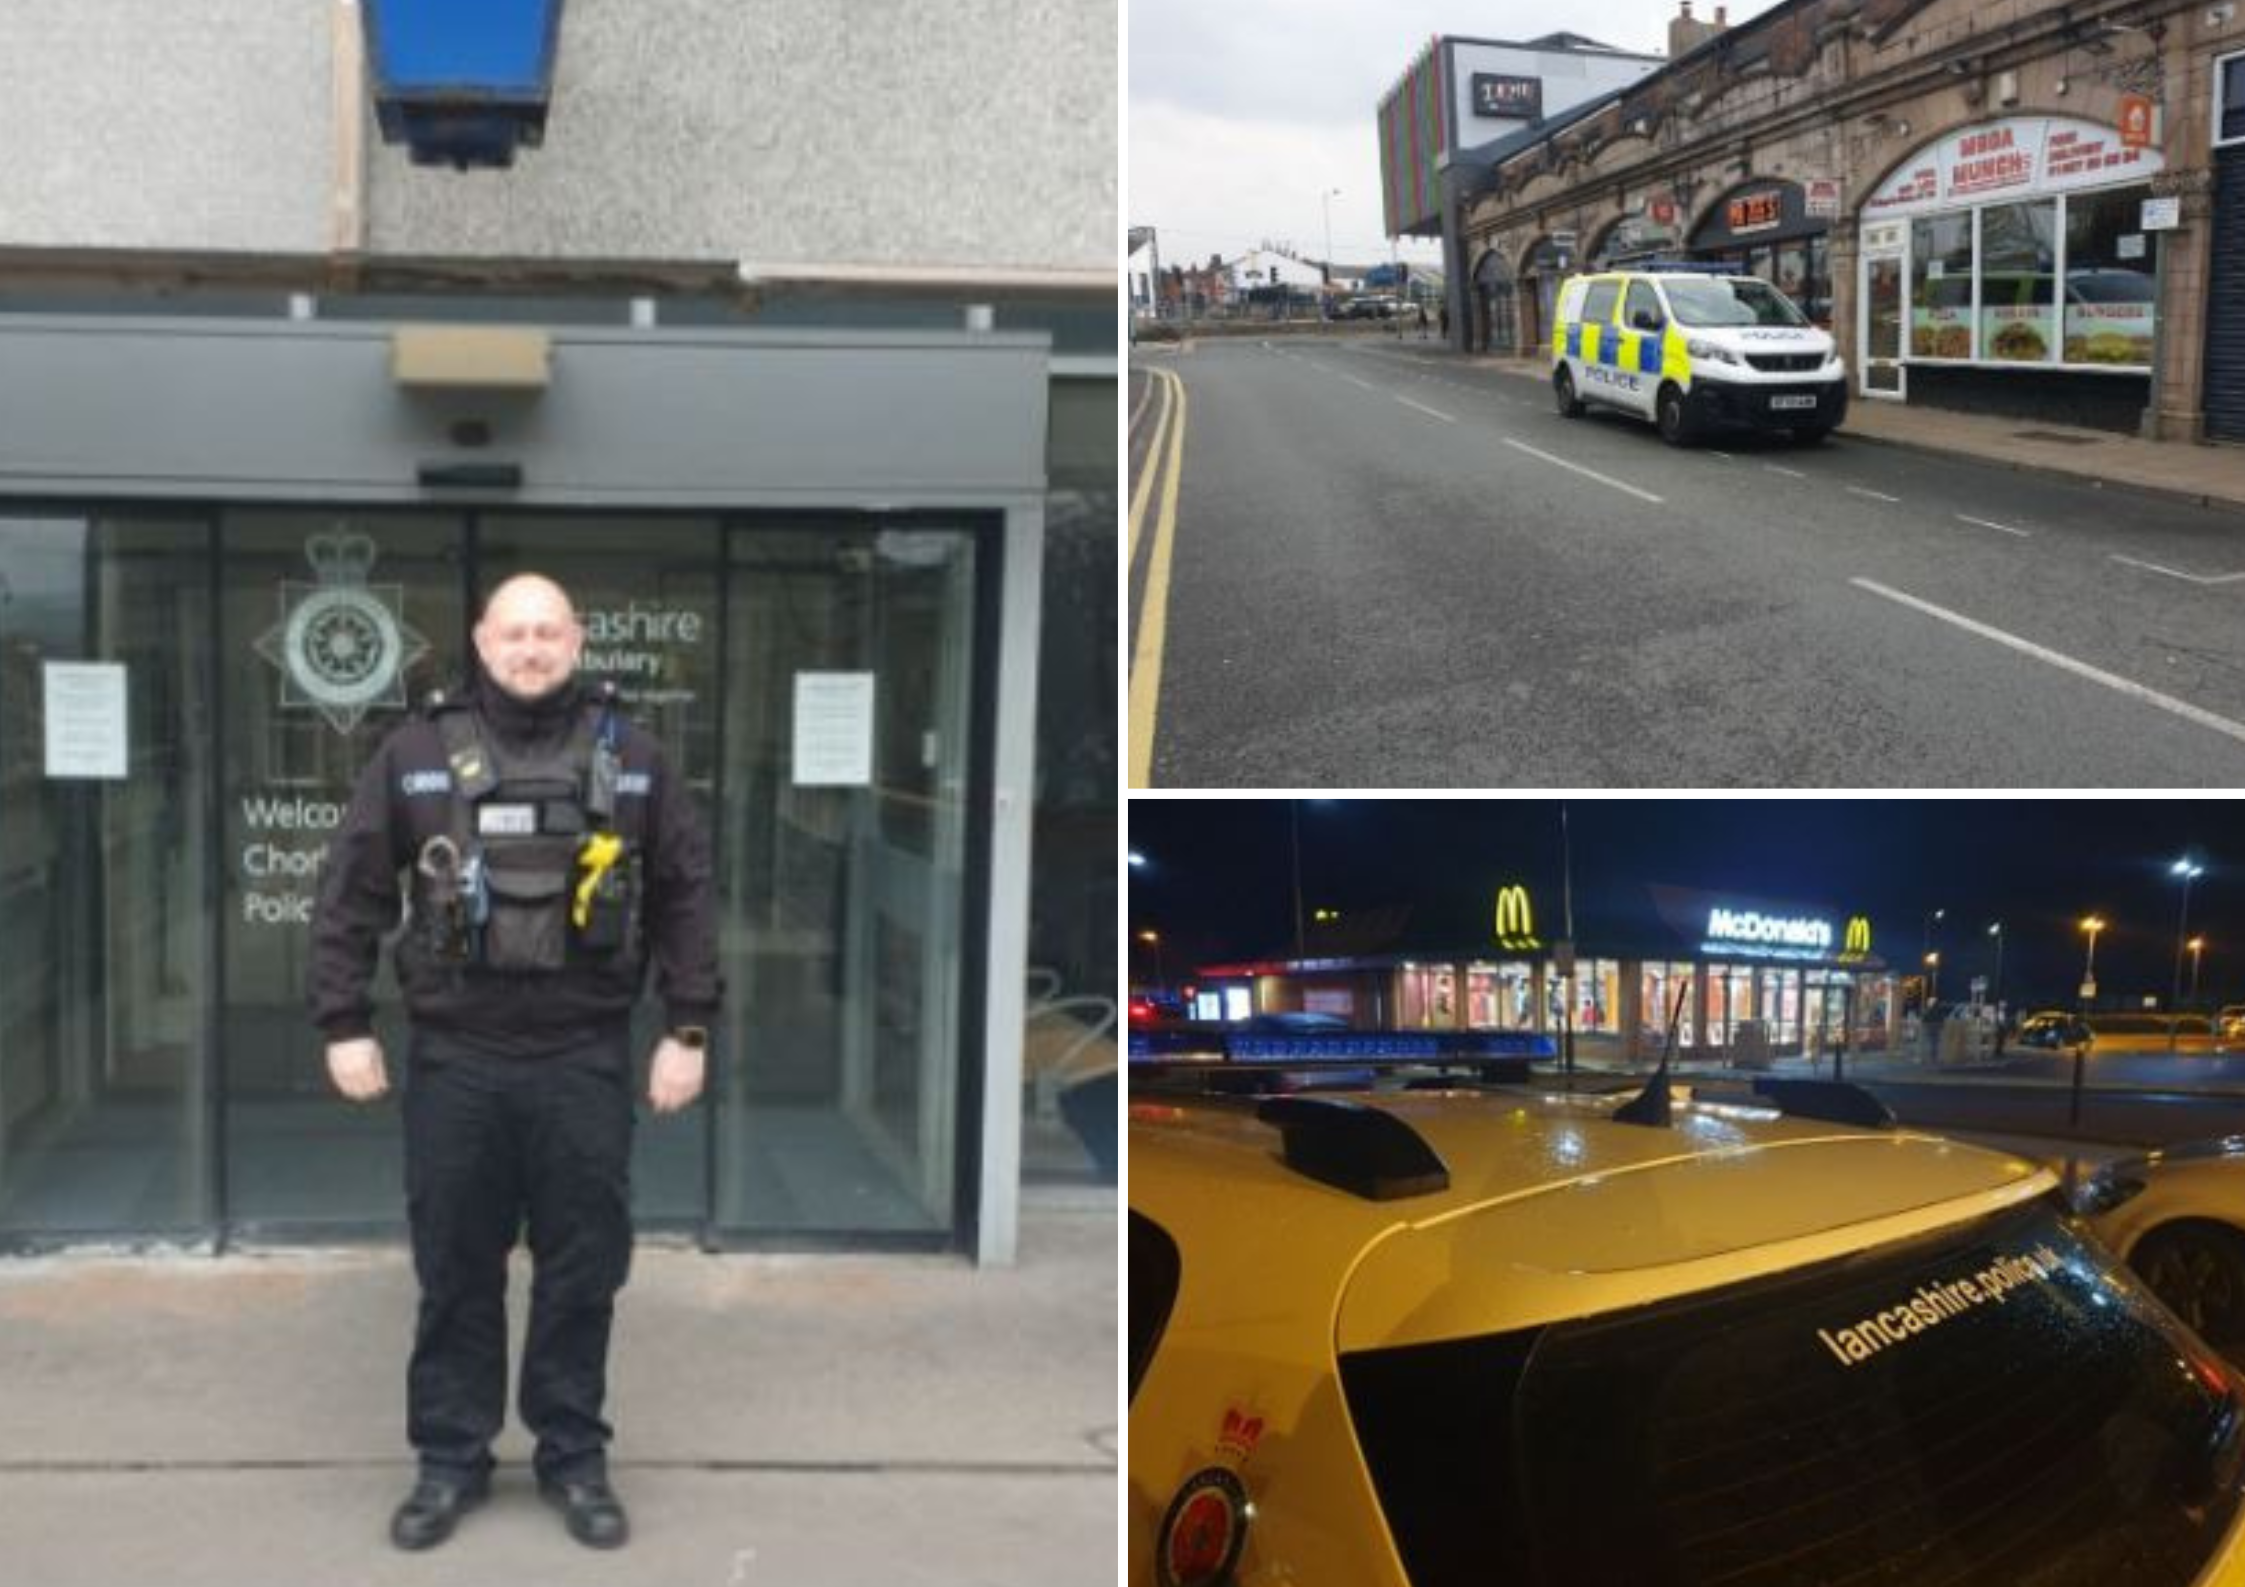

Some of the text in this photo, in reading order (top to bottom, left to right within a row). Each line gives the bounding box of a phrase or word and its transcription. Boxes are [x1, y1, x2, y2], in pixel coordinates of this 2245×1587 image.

[1584, 365, 1642, 392] POLICE
[583, 598, 703, 642] ashire
[242, 797, 346, 830] Welco
[242, 842, 329, 878] Chor
[243, 892, 315, 924] Polic
